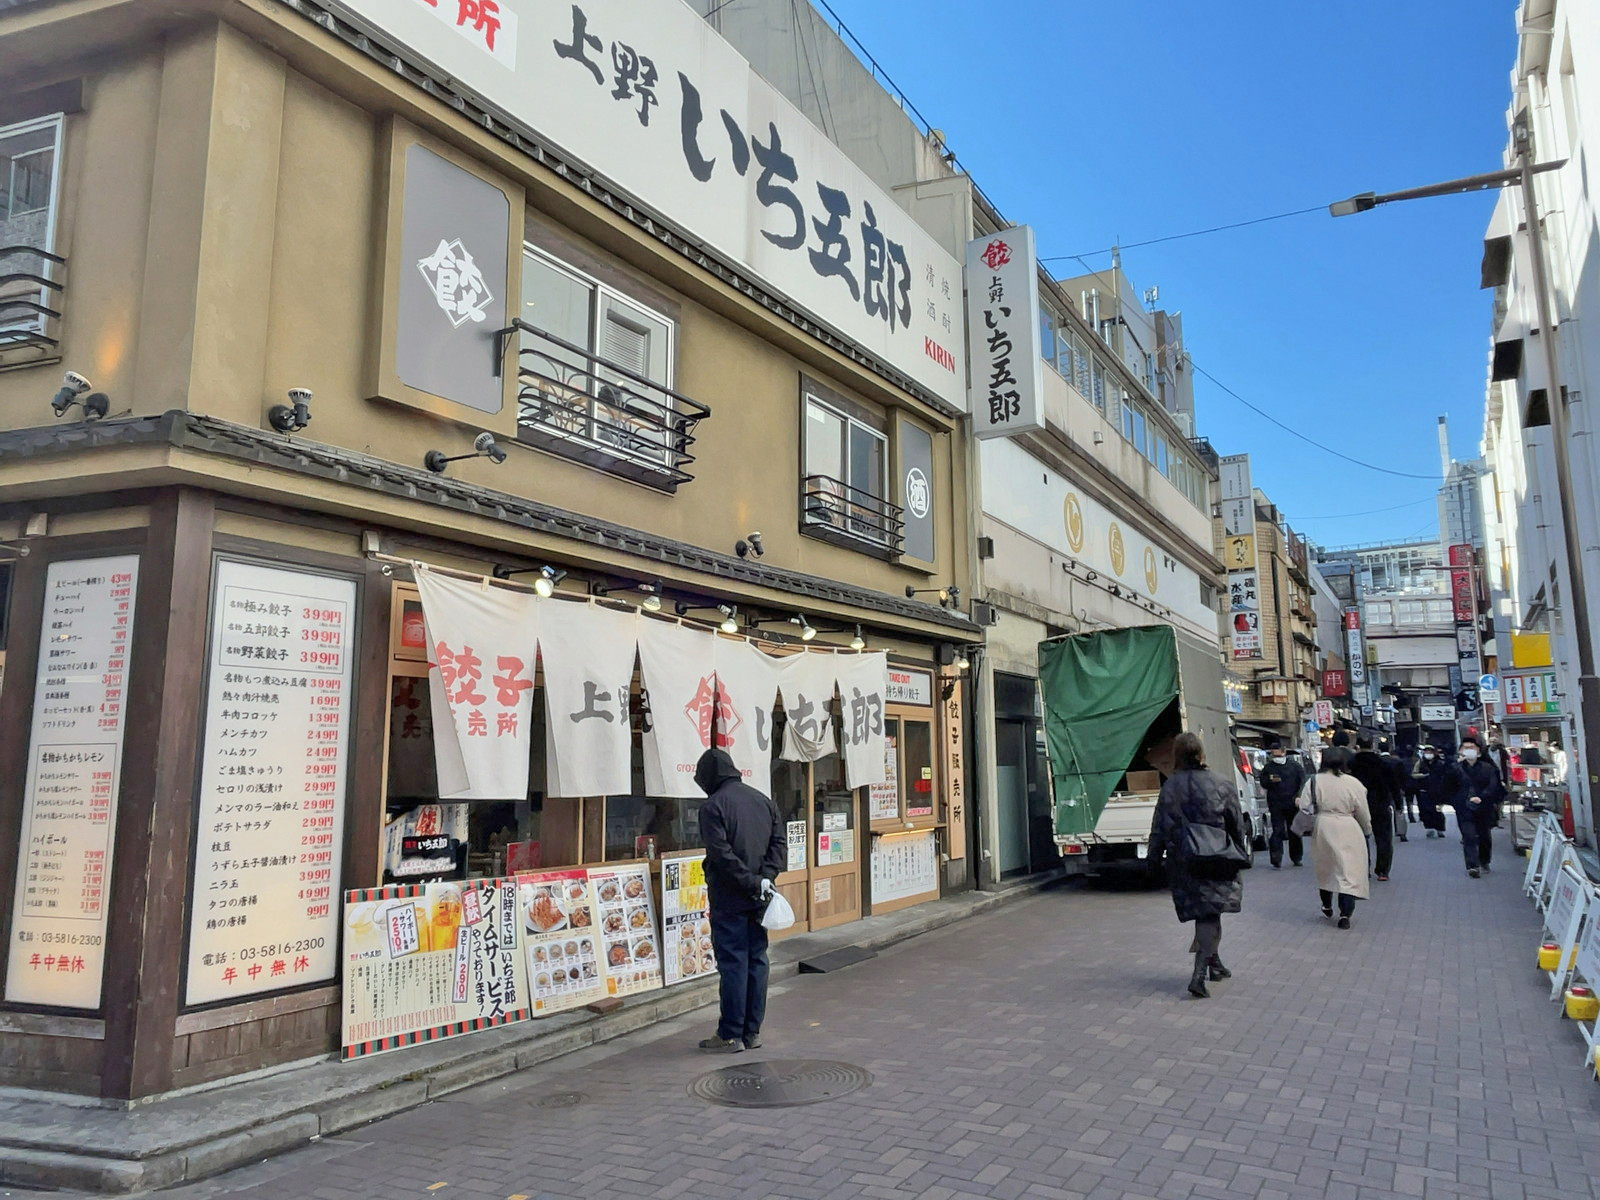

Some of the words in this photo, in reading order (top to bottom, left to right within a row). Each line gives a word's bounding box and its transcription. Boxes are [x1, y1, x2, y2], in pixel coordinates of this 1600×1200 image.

[553, 4, 659, 127] 上野
[677, 70, 912, 335] いち五郎
[984, 240, 1011, 270] 餃
[418, 238, 487, 323] 餃
[988, 275, 1004, 304] 上野
[940, 275, 952, 335] 焼酎
[924, 335, 957, 376] KIRIN
[983, 305, 1021, 426] いち五郎
[910, 473, 927, 512] 酒
[302, 608, 341, 624] 399円
[227, 622, 290, 640] 名物五郎餃子
[301, 629, 340, 645] 399円
[225, 645, 289, 662] 名物野菜餃子
[300, 651, 339, 666] 399円
[223, 671, 308, 689] 名物もつ煮込み豆腐
[310, 679, 341, 690] 399円
[435, 640, 533, 708] 餃子
[889, 672, 901, 683] TAKE
[901, 673, 911, 684] OUT
[310, 695, 340, 707] 169円
[220, 709, 278, 721] 牛肉コロッケ
[309, 712, 339, 724] 139円
[220, 728, 268, 740] メンチカツ
[307, 730, 338, 741] 249円
[218, 747, 257, 757] ハムカツ
[306, 747, 337, 758] 249円
[217, 765, 283, 777] ごま塩きゅうり
[305, 764, 336, 775] 299円
[676, 763, 698, 773] GYOZ
[216, 783, 283, 795] セロリの浅漬け
[304, 781, 335, 792] 299円
[214, 802, 299, 814] メンマのラー油和え
[303, 798, 334, 810] 299円
[213, 819, 272, 833] ポテトサラダ
[302, 816, 333, 827] 299円
[210, 841, 231, 852] 枝豆
[301, 833, 332, 845] 299円
[300, 851, 332, 864] 299円
[209, 878, 239, 890] ニラ玉
[299, 868, 331, 881] 399円
[208, 894, 258, 911] タコの唐揚
[298, 885, 330, 899] 499円
[206, 915, 247, 930] 鶏の唐揚
[405, 907, 416, 945] ハイボール
[501, 886, 515, 948] 18時までは
[458, 929, 469, 962] 生ビール
[481, 885, 505, 1019] タイムサービス
[29, 952, 85, 974] 年中無休
[222, 955, 310, 985] 年中無休
[501, 952, 517, 1005] いち五郎
